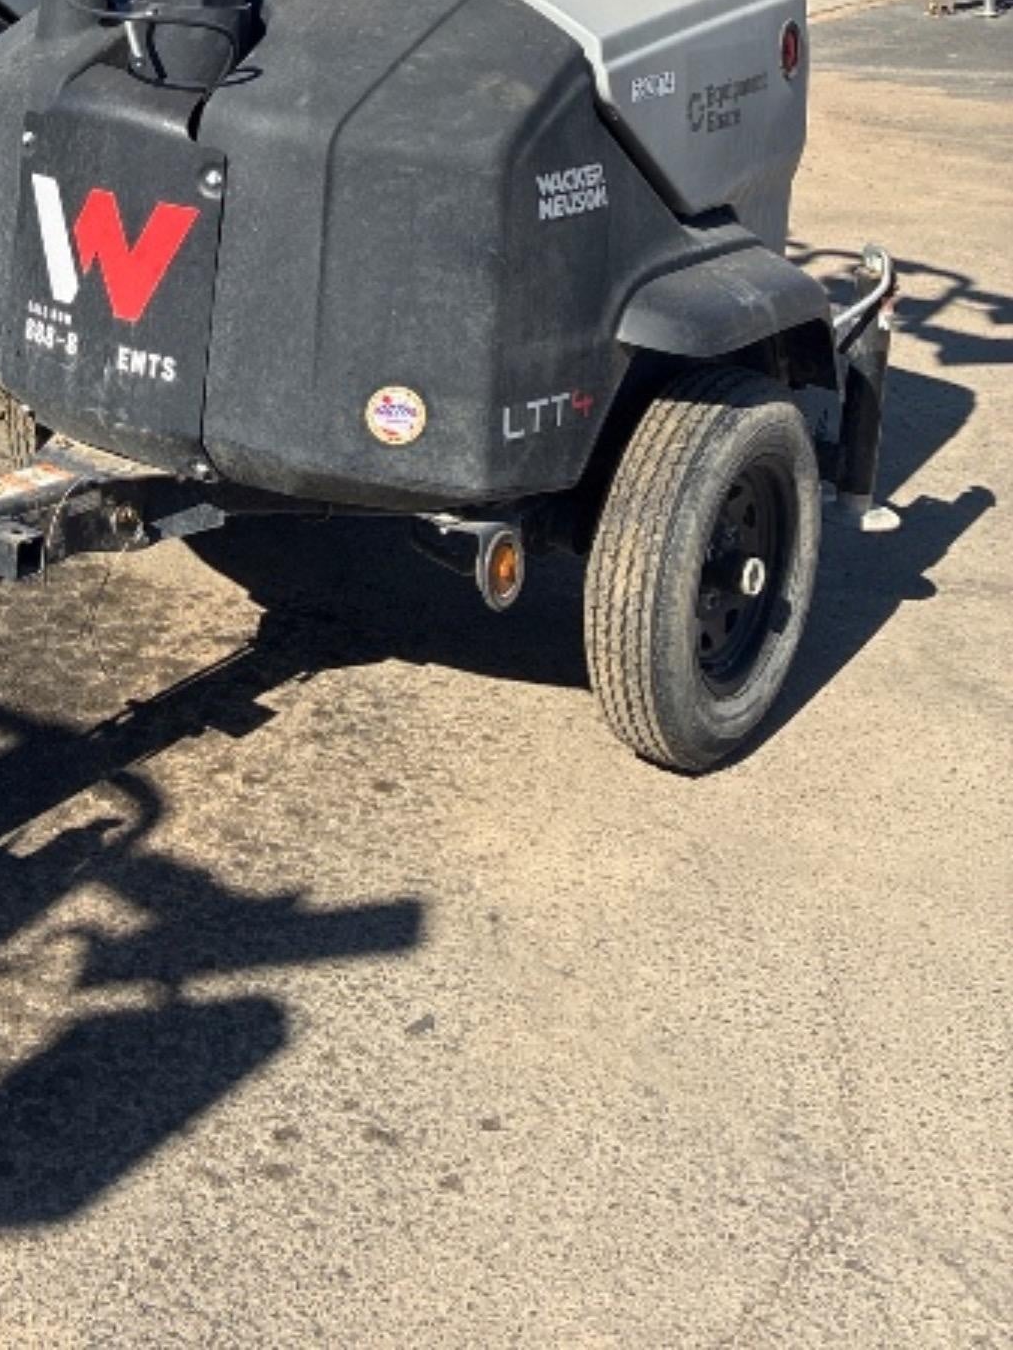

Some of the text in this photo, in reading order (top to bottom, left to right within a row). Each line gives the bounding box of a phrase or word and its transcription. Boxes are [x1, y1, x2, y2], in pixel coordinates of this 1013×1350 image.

[535, 162, 606, 196] WACKER
[538, 185, 609, 220] NEUSON
[502, 388, 594, 440] LTT4
